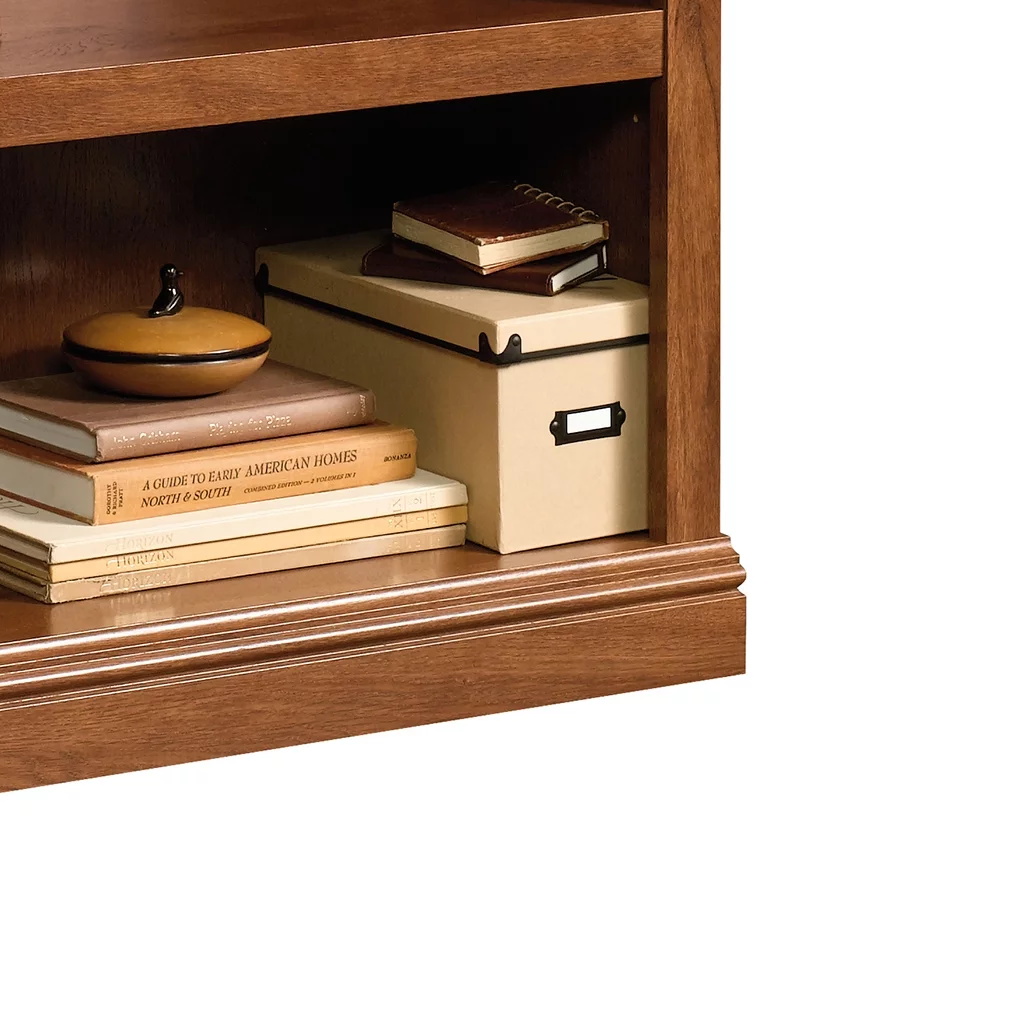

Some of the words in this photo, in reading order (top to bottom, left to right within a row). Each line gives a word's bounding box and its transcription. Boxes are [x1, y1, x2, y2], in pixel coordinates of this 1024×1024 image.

[383, 453, 412, 463] BONANZA
[142, 480, 151, 492] A
[153, 475, 188, 490] GUIDE
[190, 472, 206, 485] TO
[208, 467, 242, 483] EARLY
[245, 456, 311, 478] AMERICAN
[314, 449, 358, 468] HOMES
[243, 483, 277, 495] COMBINED
[277, 478, 303, 490] EDITION
[141, 492, 182, 509] NORTH
[183, 491, 192, 503] &
[193, 485, 232, 502] SOUTH
[106, 550, 175, 568] HORIZON
